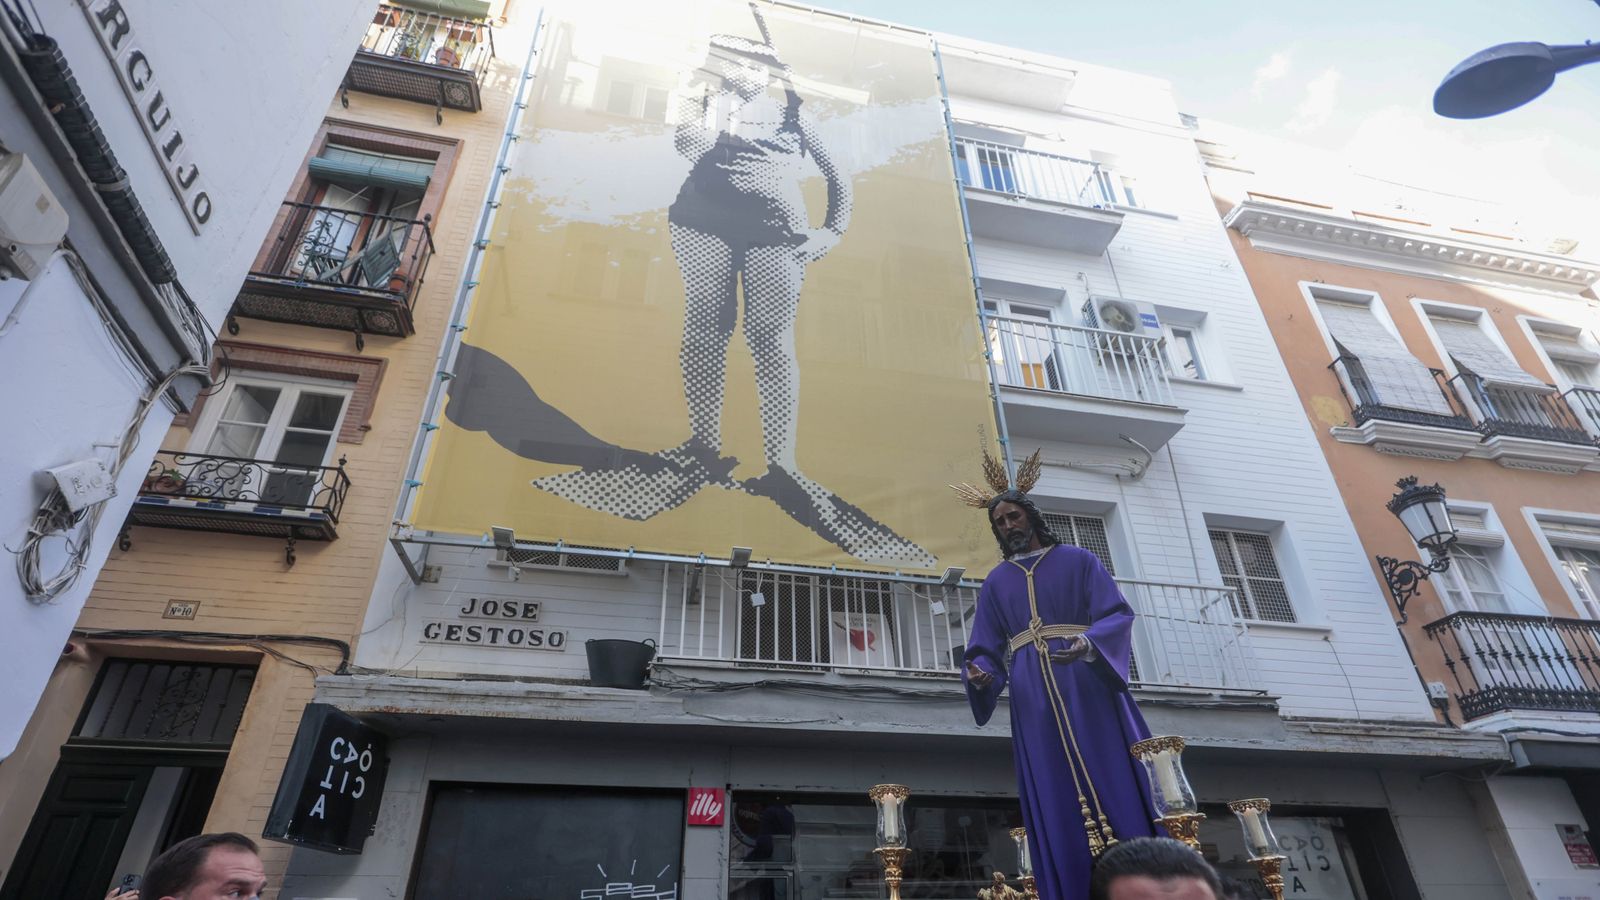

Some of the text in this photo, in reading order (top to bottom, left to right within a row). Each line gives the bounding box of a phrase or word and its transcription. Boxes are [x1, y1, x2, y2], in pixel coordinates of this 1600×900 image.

[461, 598, 539, 619] JOSE
[424, 622, 565, 647] GESTOSO
[690, 793, 722, 821] illy
